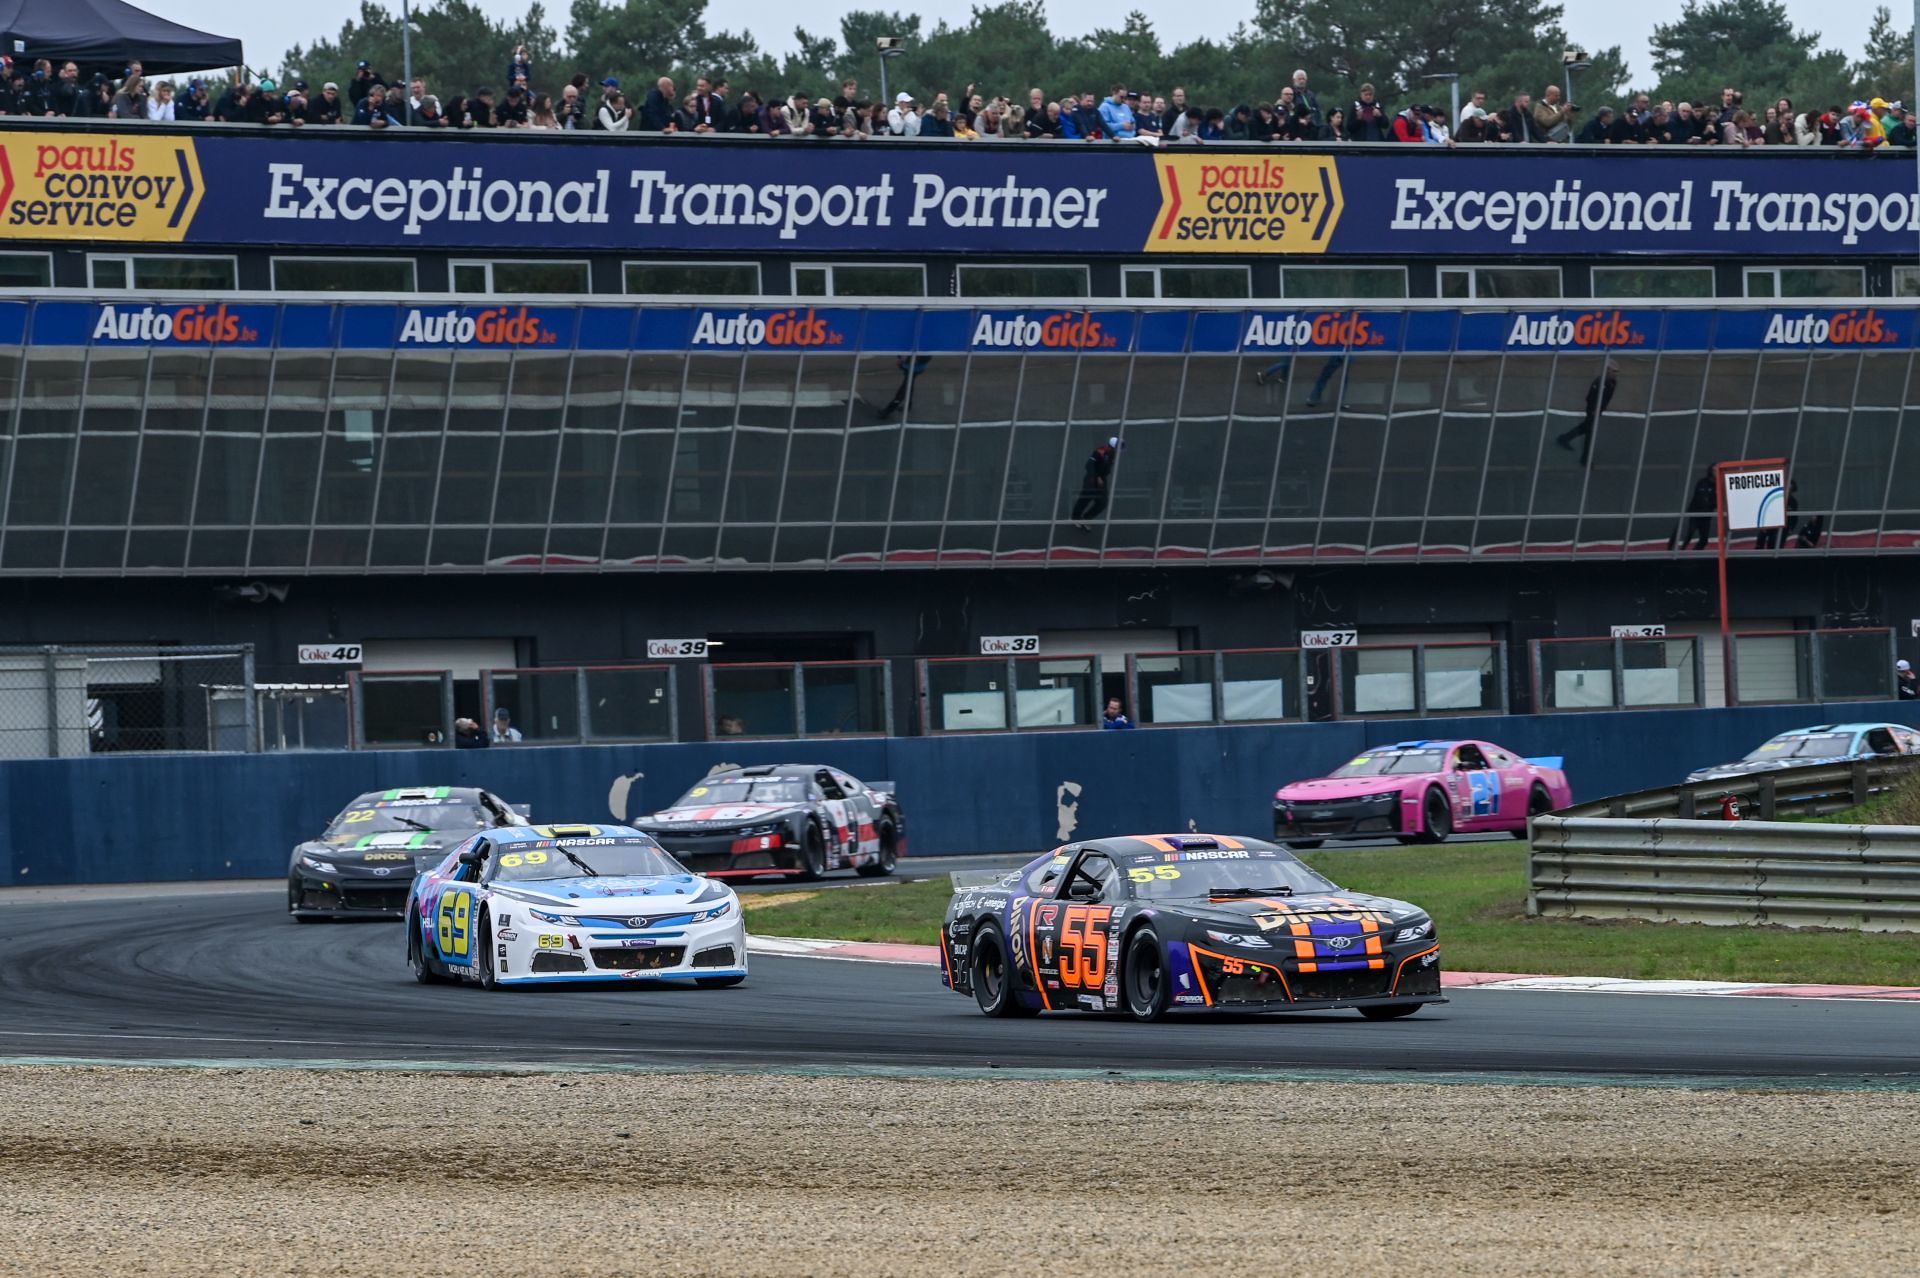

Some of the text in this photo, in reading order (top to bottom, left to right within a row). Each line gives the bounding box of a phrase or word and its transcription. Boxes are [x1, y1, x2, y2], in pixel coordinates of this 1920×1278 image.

[37, 139, 135, 178] pauls
[1199, 159, 1285, 195] pauls
[46, 173, 175, 208] convoy
[263, 162, 1107, 239] Exceptional Transport Partner
[1207, 190, 1319, 222] convoy
[10, 198, 137, 227] service
[1390, 178, 1693, 244] Exceptional
[1176, 216, 1286, 241] service
[1729, 473, 1781, 490] PROFICLEAN
[982, 638, 1037, 651] Coke 38
[1303, 633, 1355, 646] Coke 37
[300, 647, 360, 660] Coke 40
[649, 642, 706, 655] Coke 39
[690, 787, 709, 798] 9
[346, 810, 376, 823] 22
[556, 838, 616, 847] NASCAR
[760, 837, 770, 848] 9
[364, 852, 408, 861] DINOIL
[500, 851, 548, 867] 69
[1186, 850, 1250, 860] NASCAR
[1128, 865, 1181, 882] 55
[438, 889, 471, 958] 69
[538, 934, 564, 948] 69
[1059, 904, 1112, 989] 55
[1222, 956, 1245, 974] 55
